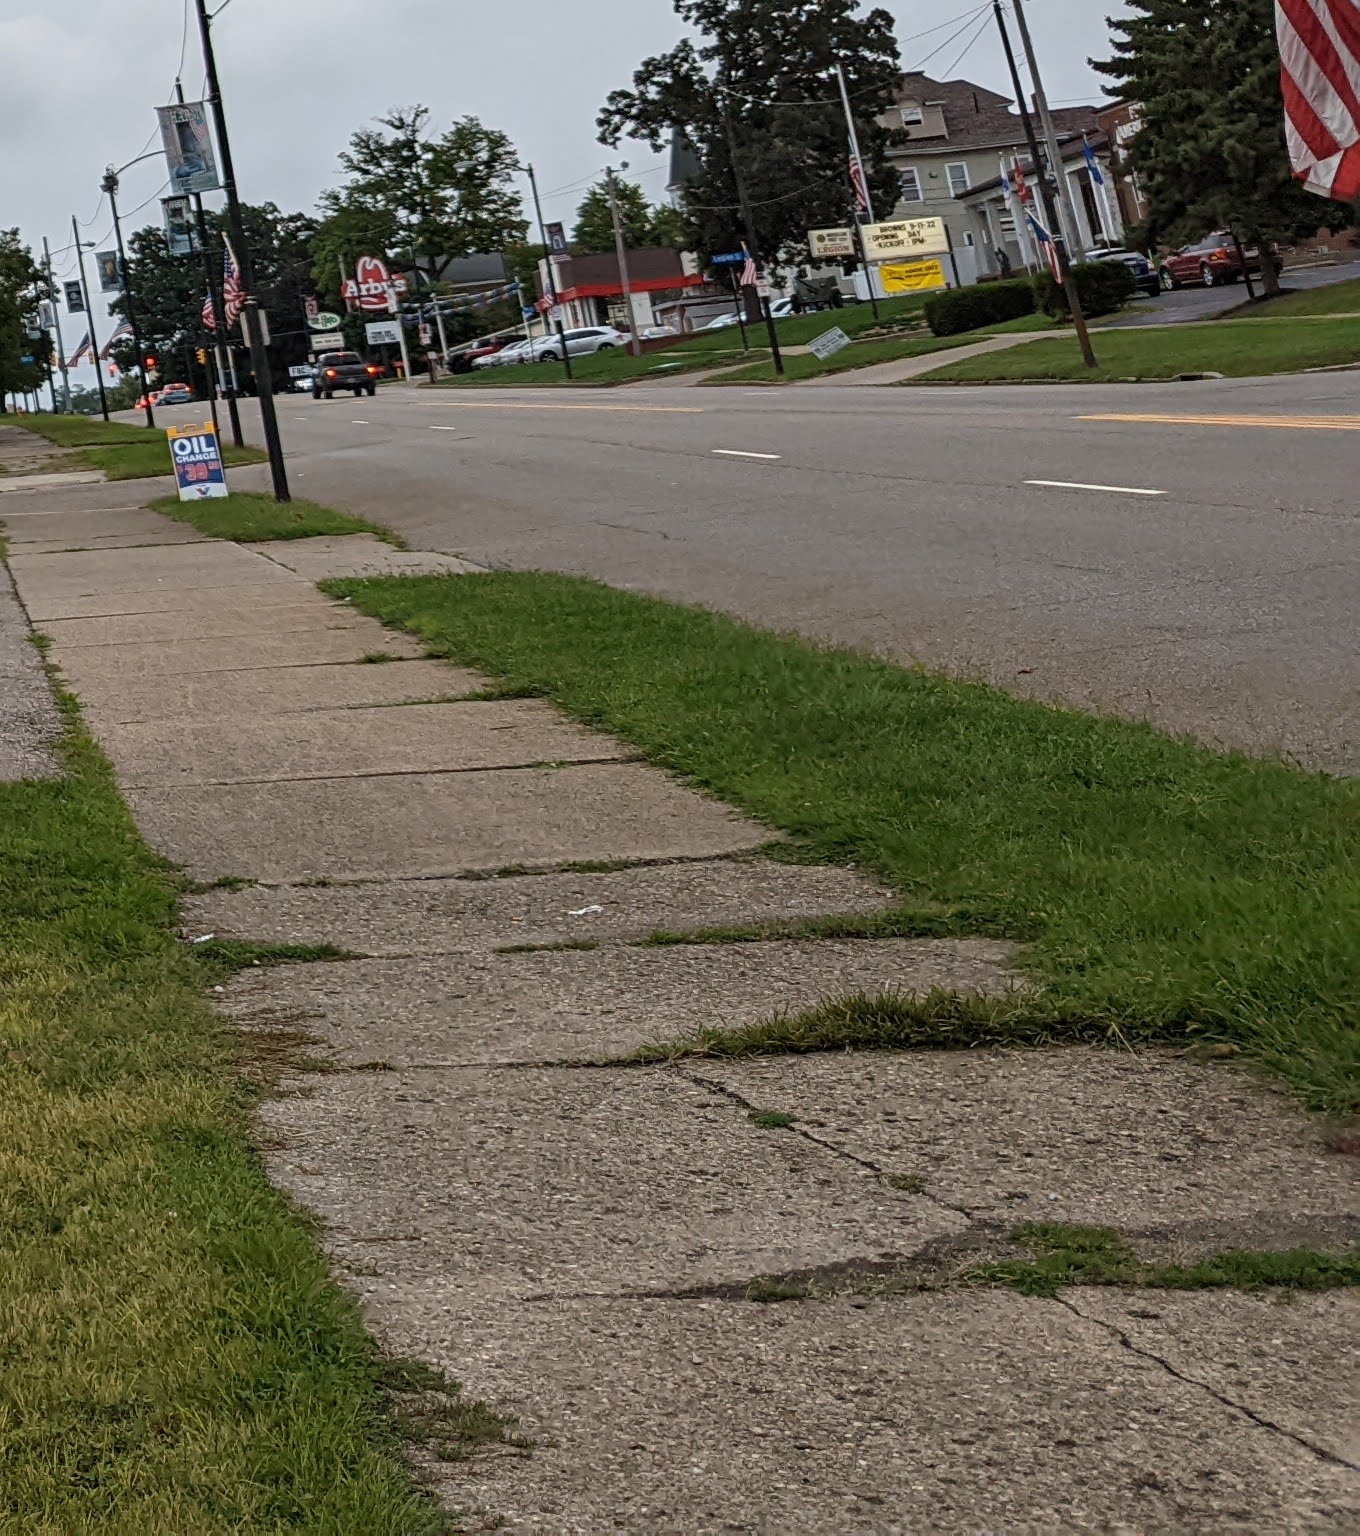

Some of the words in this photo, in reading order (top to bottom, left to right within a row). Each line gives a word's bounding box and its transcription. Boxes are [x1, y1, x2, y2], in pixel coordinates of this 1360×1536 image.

[343, 277, 407, 298] Arby's
[173, 435, 216, 456] OIL
[175, 452, 219, 463] CHANGE
